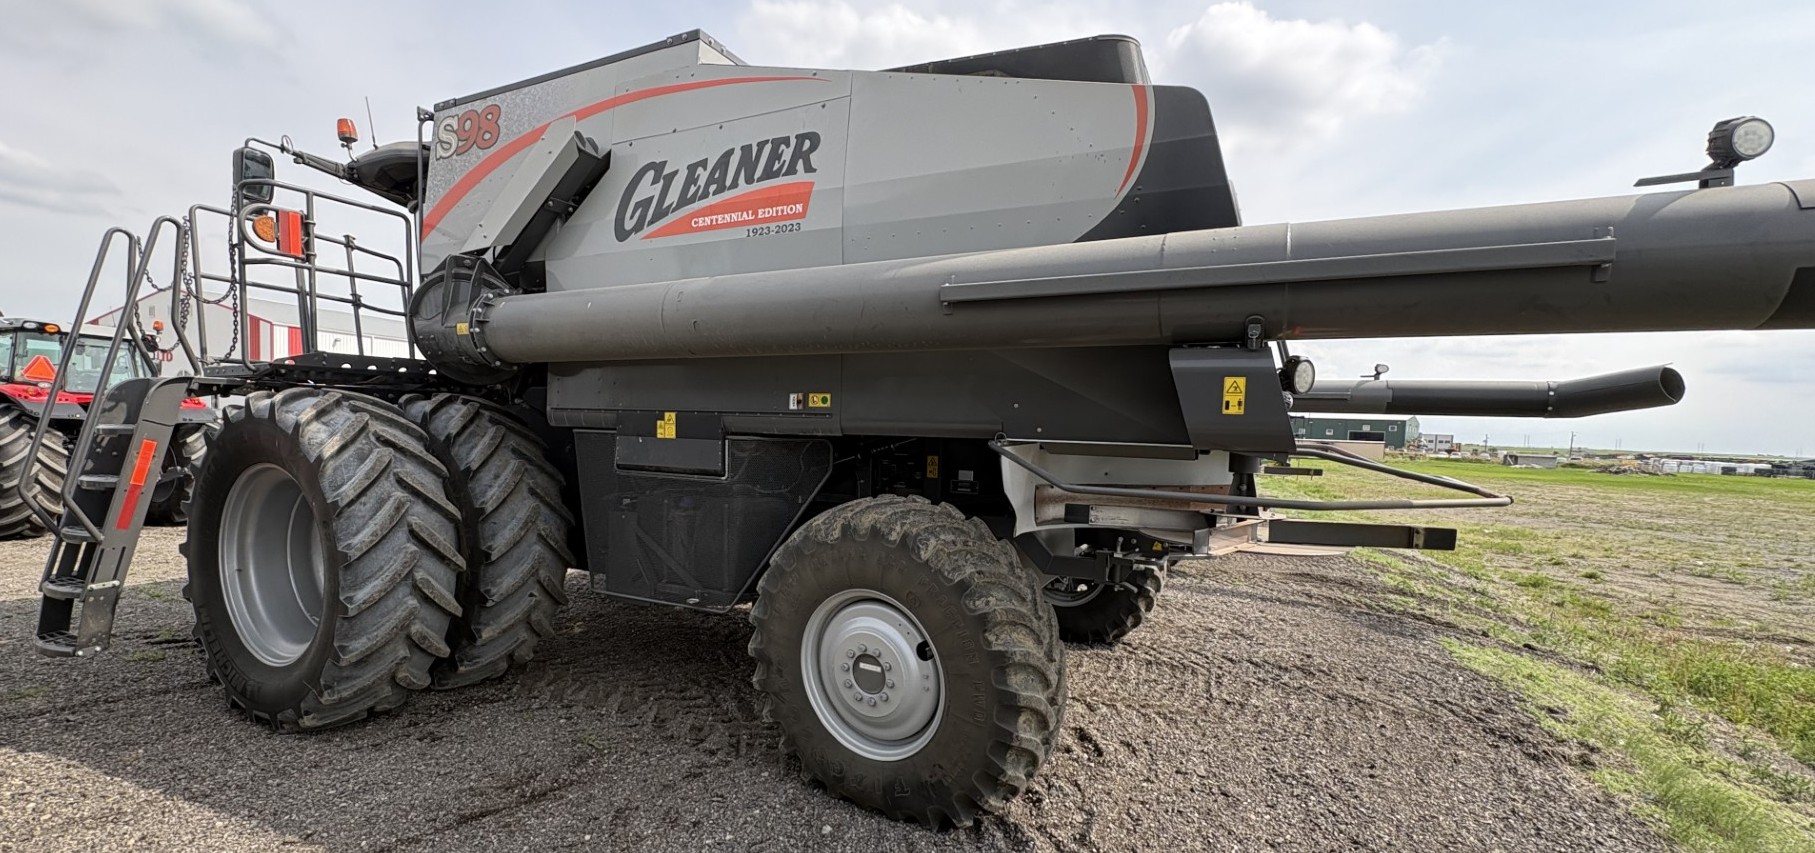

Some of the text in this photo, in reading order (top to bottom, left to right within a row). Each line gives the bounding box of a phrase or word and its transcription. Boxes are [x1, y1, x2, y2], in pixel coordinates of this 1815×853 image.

[435, 103, 501, 161] S98
[614, 131, 821, 242] GLEANER
[691, 203, 804, 228] CENTENNIAL EDITION
[746, 222, 802, 238] 1923-2023
